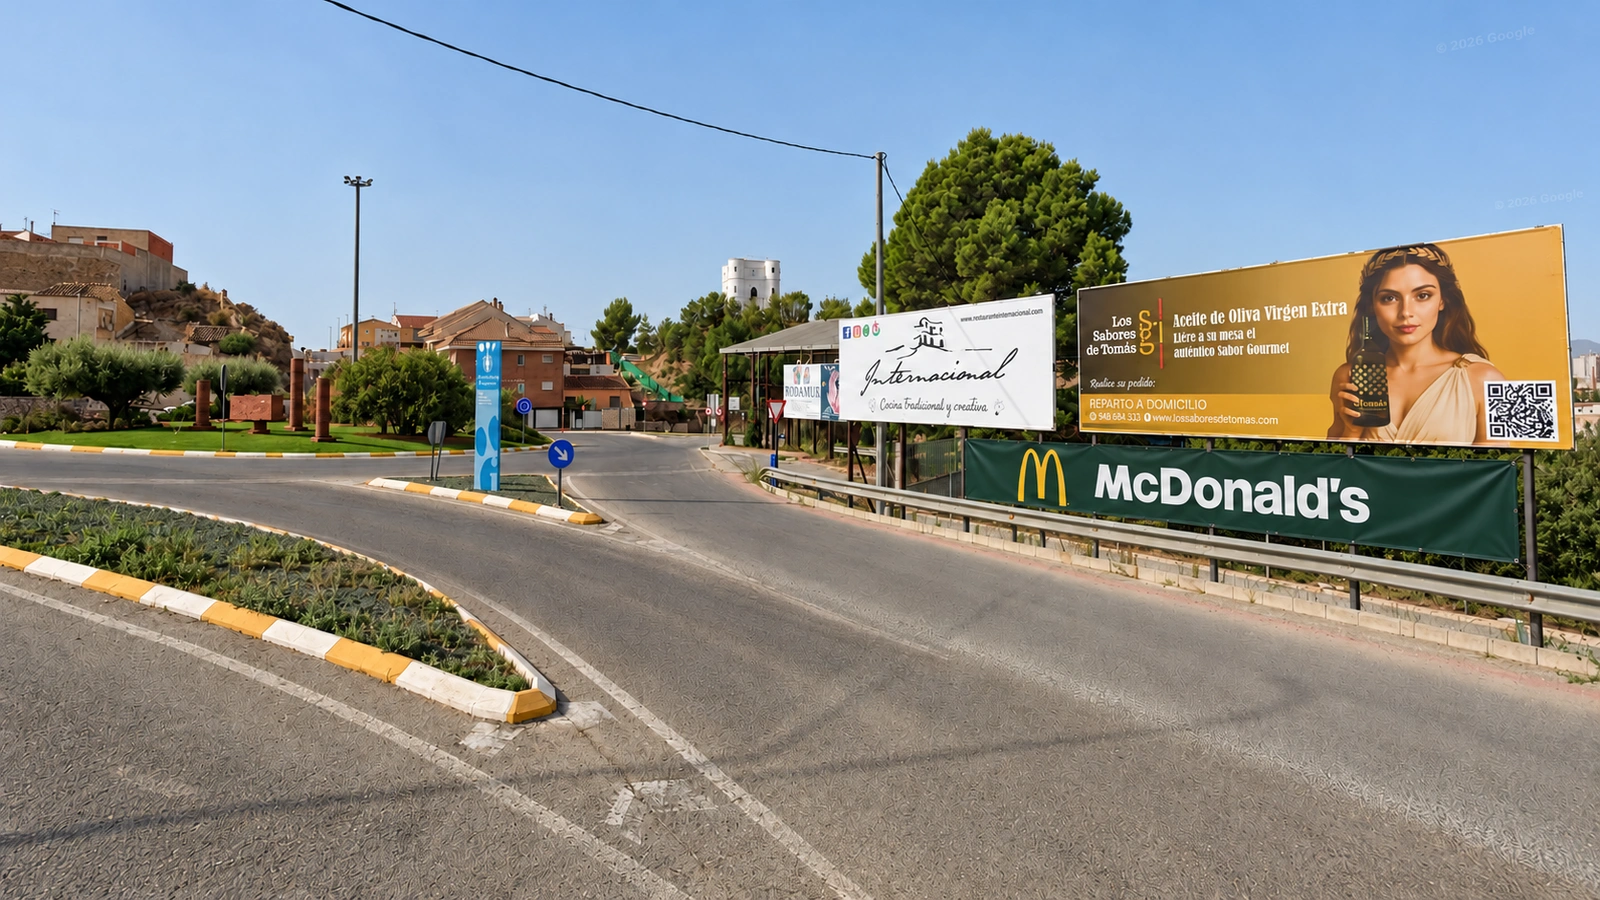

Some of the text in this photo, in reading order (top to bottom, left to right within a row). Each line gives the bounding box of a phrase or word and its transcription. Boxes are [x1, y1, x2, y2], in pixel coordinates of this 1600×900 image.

[1111, 315, 1133, 328] Los
[1173, 300, 1348, 328] Aceite de Oliva Virgen Extra
[1092, 329, 1137, 342] Sabores
[1198, 332, 1204, 342] a
[1206, 331, 1217, 342] su
[1219, 329, 1244, 341] mesa
[1246, 327, 1256, 340] el
[1086, 341, 1137, 356] de Tomás
[1173, 342, 1290, 358] auténtico Sabor Gourmet
[860, 347, 1019, 397] Internacional
[1117, 379, 1126, 388] su
[1127, 376, 1156, 390] pedido:
[879, 396, 988, 418] Cocina tradicional y creativa
[1089, 398, 1207, 411] REPARTO A DOMICILIO
[1152, 412, 1279, 425] www.lossaboresdetomas.com
[1094, 463, 1371, 524] McDonald's
